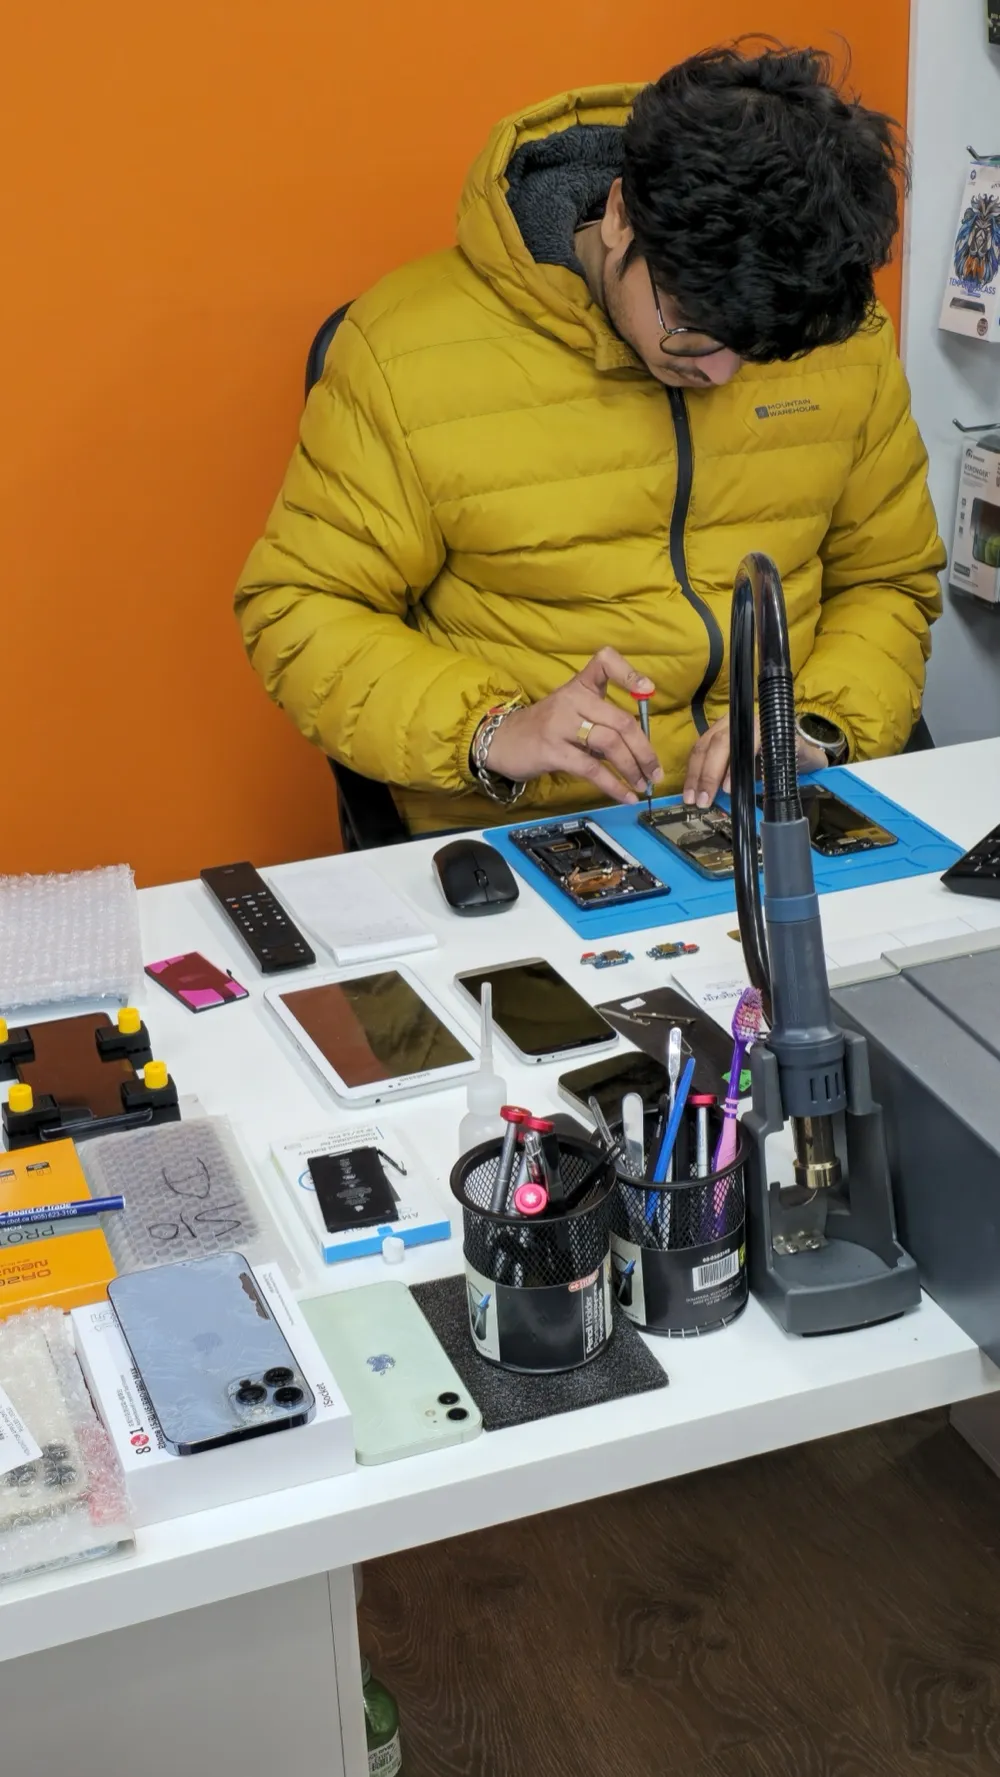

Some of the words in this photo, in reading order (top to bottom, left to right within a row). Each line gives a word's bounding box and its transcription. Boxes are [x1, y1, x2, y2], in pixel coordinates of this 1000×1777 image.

[768, 399, 811, 410] MOUNTAIN
[770, 404, 821, 417] WAREHOUSE
[8, 1206, 36, 1217] Board
[47, 1201, 72, 1211] Trade
[585, 1296, 593, 1323] Holder
[586, 1325, 594, 1354] Pencil
[316, 1382, 334, 1408] iSocket
